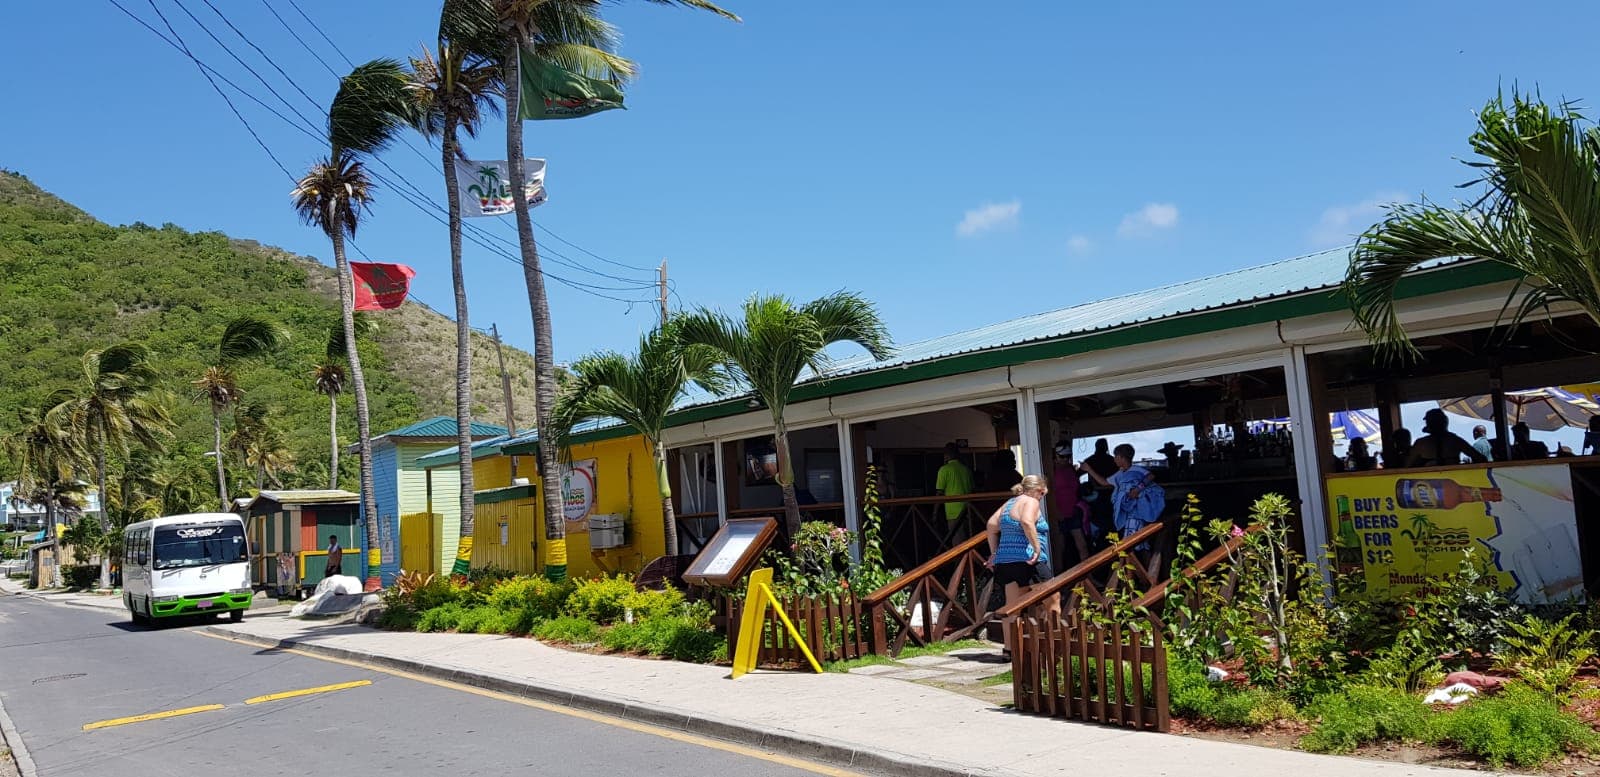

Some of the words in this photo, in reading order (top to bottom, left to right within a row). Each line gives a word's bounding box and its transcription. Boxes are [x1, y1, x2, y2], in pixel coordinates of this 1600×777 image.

[1354, 498, 1381, 512] BUY
[1385, 497, 1395, 511] 3
[1354, 514, 1399, 529] BEERS
[1364, 532, 1393, 546] FOR
